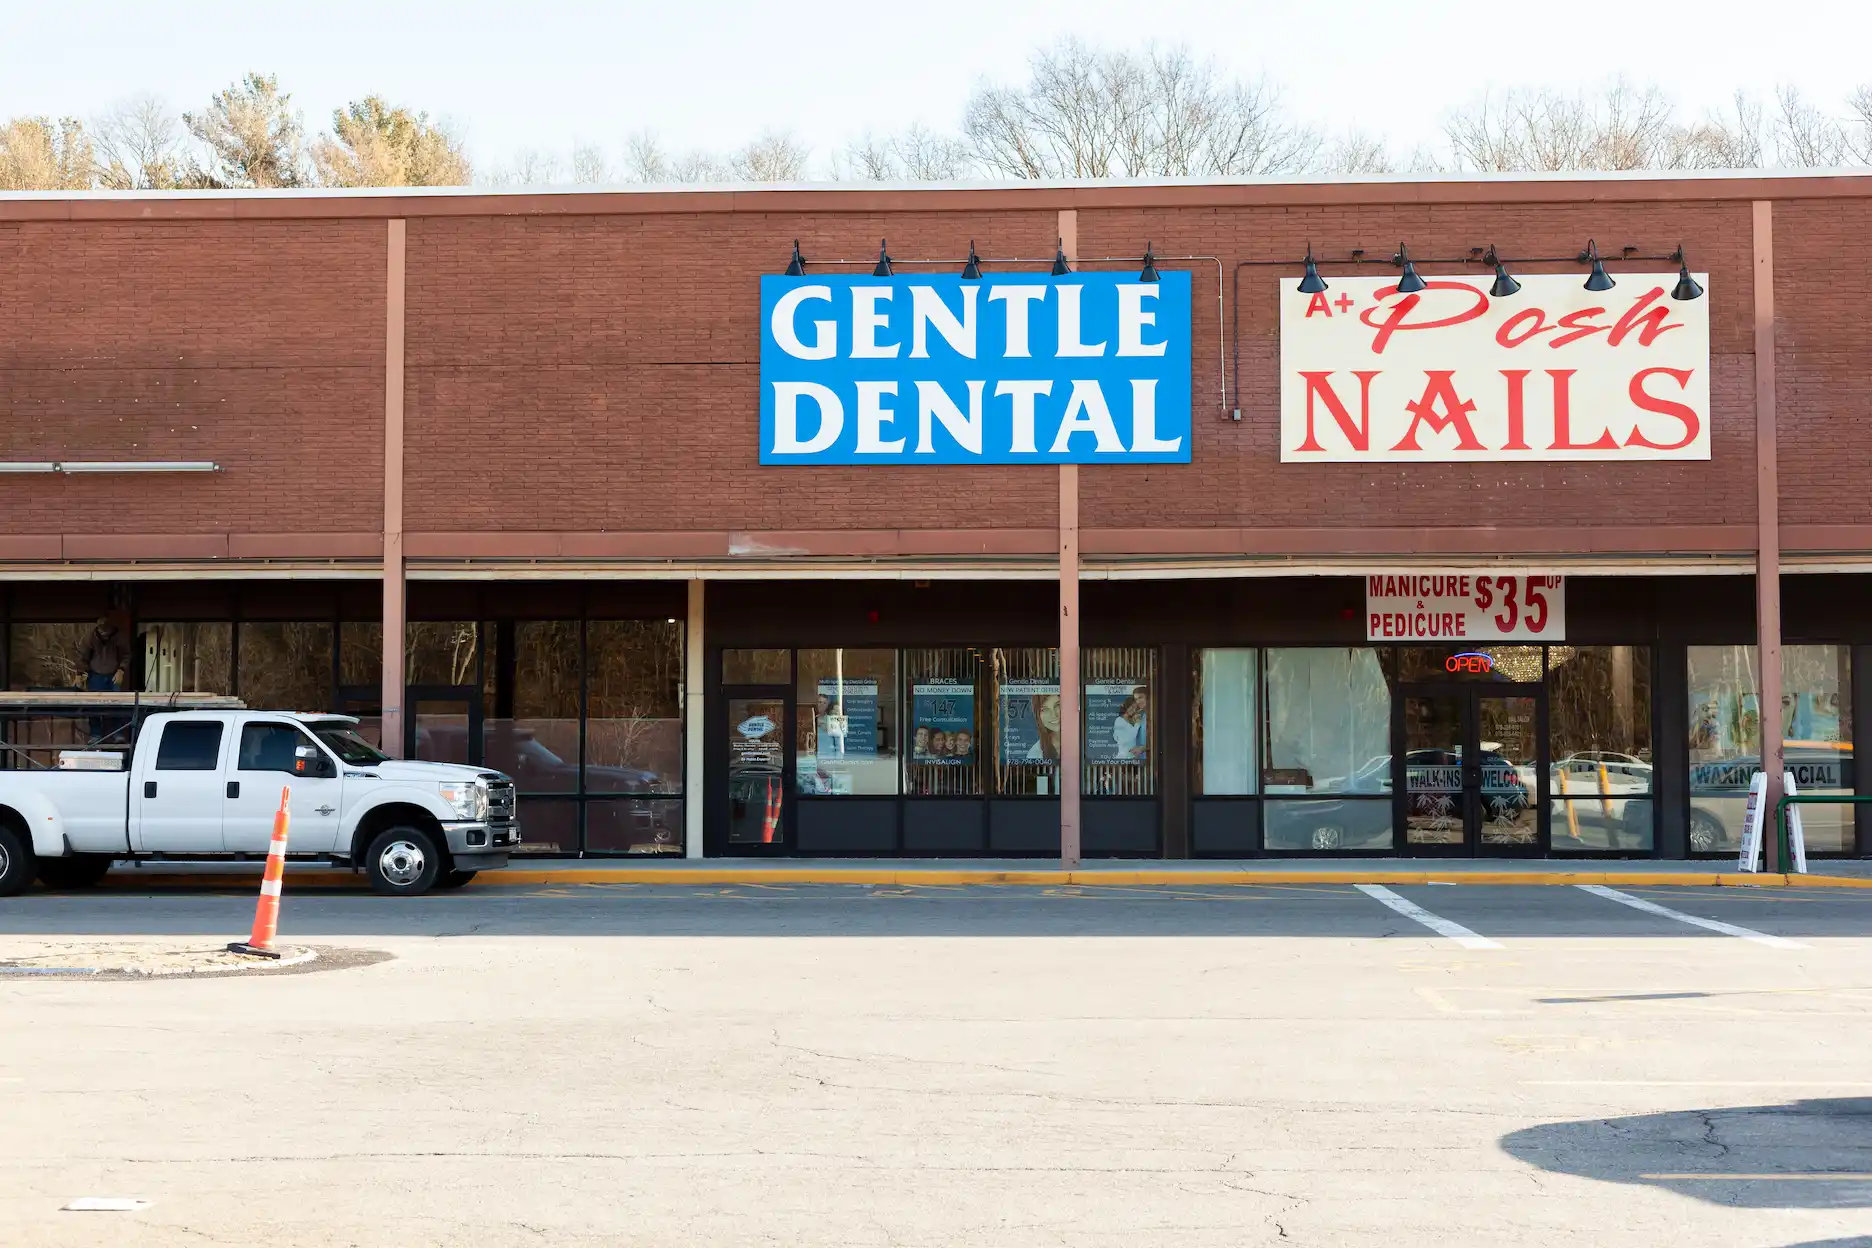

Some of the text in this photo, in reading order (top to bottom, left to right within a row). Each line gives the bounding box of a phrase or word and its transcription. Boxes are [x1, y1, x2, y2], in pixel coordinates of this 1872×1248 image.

[771, 284, 1168, 360] GENTLE
[1359, 281, 1684, 354] Posh
[771, 379, 1182, 454] DENTAL
[1293, 367, 1700, 451] NAILS
[1369, 576, 1561, 633] MANICURE $35 UP
[1416, 600, 1425, 609] &
[1370, 613, 1466, 637] PEDICURE
[1445, 656, 1490, 673] OPEN
[1410, 770, 1461, 787] WALK-INS
[1784, 766, 1836, 784] ACIAL
